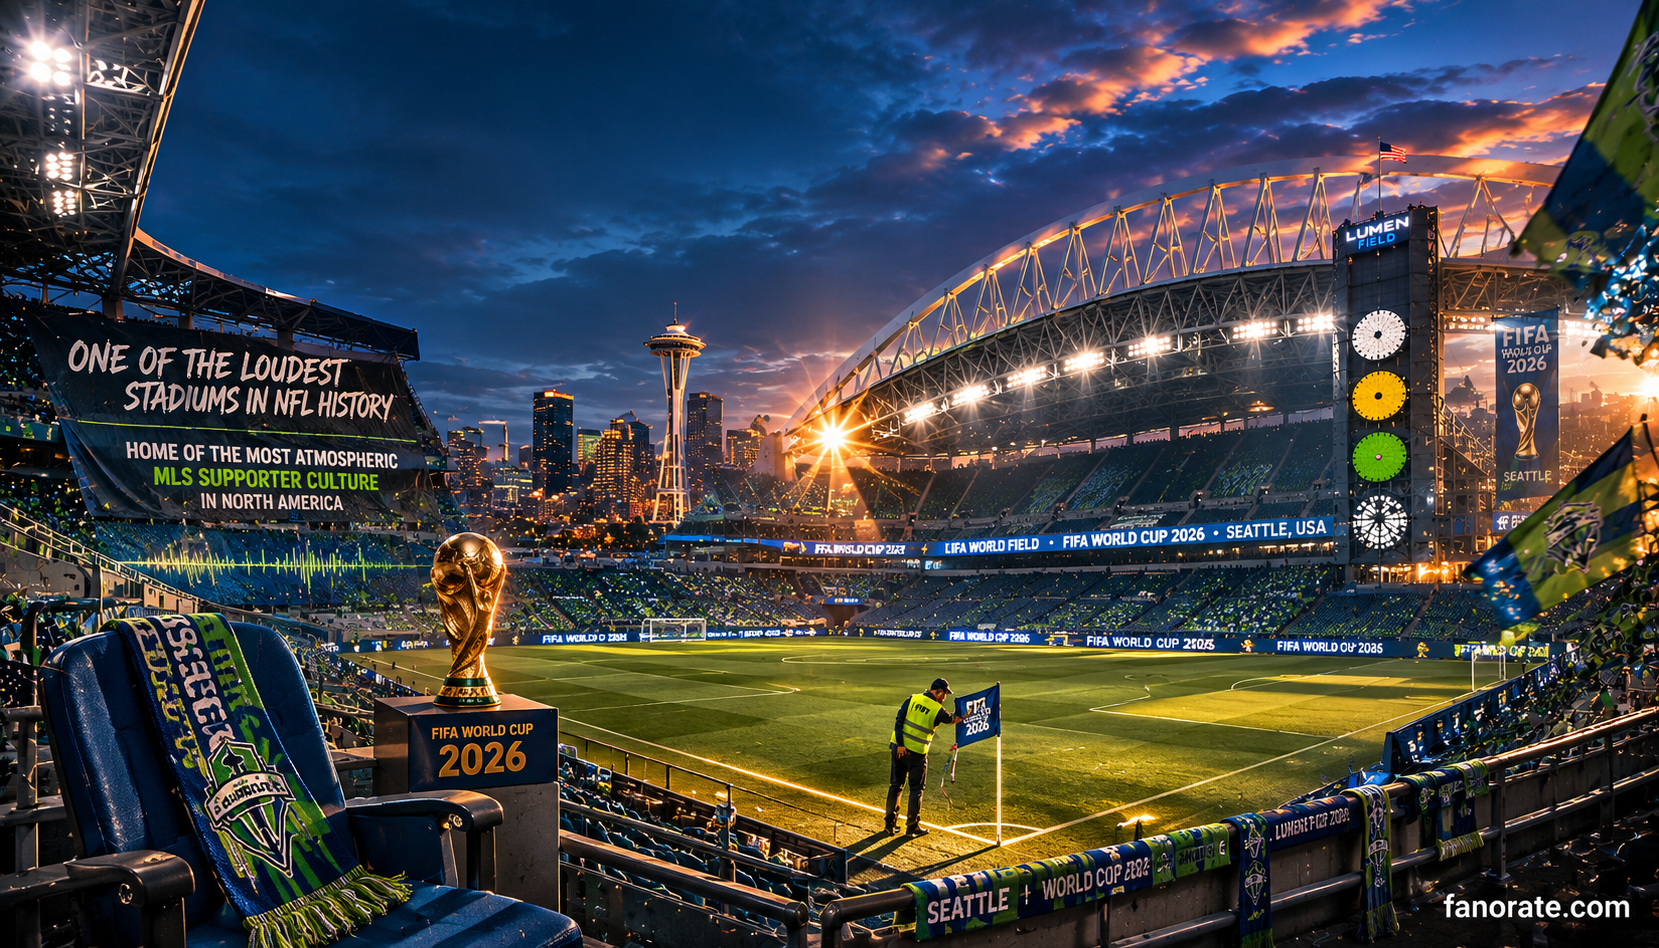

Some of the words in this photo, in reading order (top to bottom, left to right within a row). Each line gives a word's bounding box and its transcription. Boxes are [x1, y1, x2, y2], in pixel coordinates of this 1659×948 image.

[1346, 216, 1409, 242] LUMEN
[1358, 233, 1396, 249] FIELD
[1503, 324, 1549, 347] FIFA
[68, 339, 130, 374] ONE
[139, 345, 178, 379] OF
[182, 348, 234, 380] THE
[240, 351, 350, 387] LOUDEST
[1507, 355, 1547, 374] 2026
[124, 381, 240, 415] STADIUMS
[246, 386, 269, 415] IN
[274, 388, 314, 418] NFL
[318, 390, 394, 423] HISTORY
[126, 441, 179, 461] HOME
[183, 444, 205, 462] OF
[209, 445, 242, 463] THE
[246, 447, 291, 465] MOST
[295, 449, 399, 469] ATMOSPHERIC
[153, 466, 193, 486] MLS
[198, 467, 302, 489] SUPPORTER
[307, 471, 379, 491] CULTURE
[200, 493, 216, 509] IN
[222, 493, 274, 510] NORTH
[278, 494, 344, 511] AMERICA
[1008, 538, 1039, 551] FIELD
[1063, 535, 1088, 548] FIFA
[1091, 532, 1137, 547] WORLD
[1140, 530, 1168, 544] CUP
[1171, 527, 1205, 542] 2026
[1226, 522, 1292, 538] SEATTLE,
[1296, 520, 1327, 535] USA
[1086, 636, 1109, 647] FIFA
[1113, 637, 1152, 648] WORLD
[1277, 641, 1300, 651] FIFA
[1302, 642, 1338, 652] WORLD
[431, 727, 459, 740] FIFA
[461, 724, 506, 738] WORLD
[509, 723, 534, 736] CUP
[966, 721, 989, 736] 2026
[438, 740, 527, 778] 2026
[927, 887, 1010, 924] SEATTLE
[1042, 870, 1093, 901] WORLD
